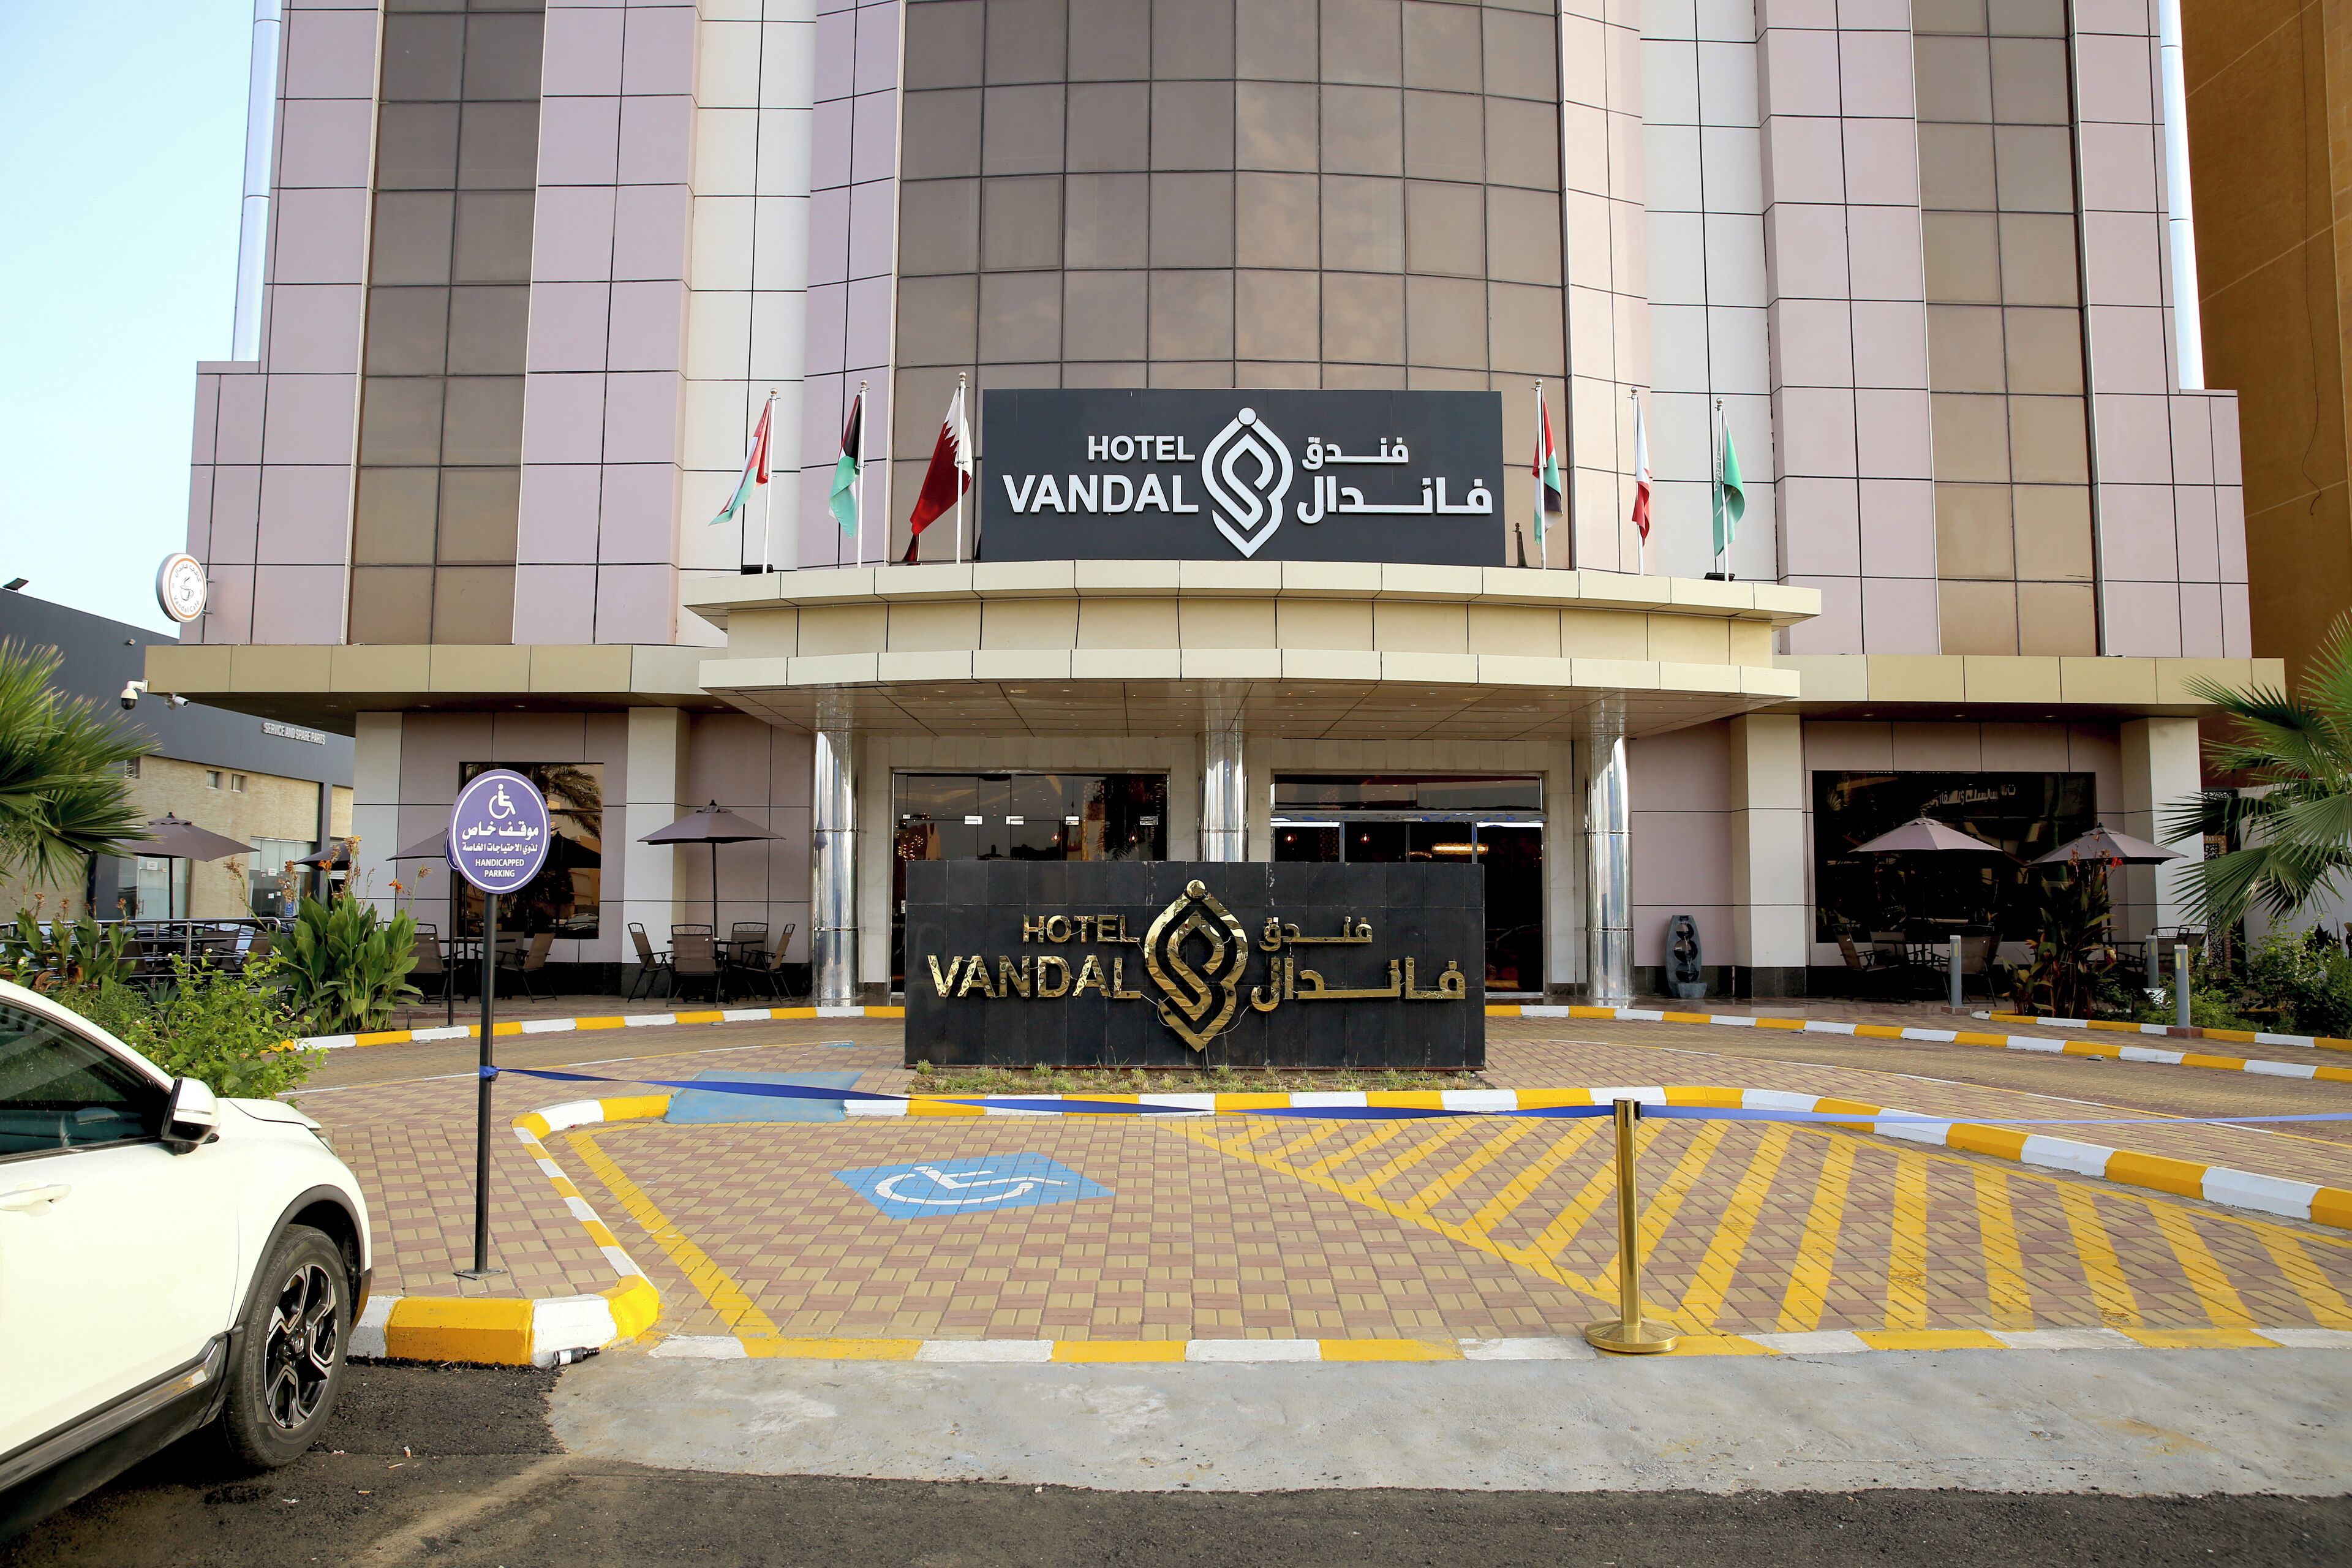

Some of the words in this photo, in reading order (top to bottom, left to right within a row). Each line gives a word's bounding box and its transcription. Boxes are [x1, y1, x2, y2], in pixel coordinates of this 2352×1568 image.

[1087, 435, 1196, 461] HOTEL
[1302, 436, 1409, 470] فندق
[1002, 473, 1200, 513] VANDAL
[1297, 475, 1494, 524] فاندال
[174, 595, 189, 612] Vandal
[263, 723, 285, 736] SERVICE
[285, 727, 295, 739] AND
[295, 729, 311, 742] SPARE
[311, 732, 325, 745] PARTS
[462, 821, 496, 840] خاص
[499, 820, 539, 841] موقف
[462, 842, 486, 852] الخاصة
[475, 858, 525, 867] HANDICAPPED
[484, 869, 515, 878] PARKING
[1023, 914, 1140, 943] HOTEL
[1259, 916, 1373, 951] فندق
[927, 954, 1142, 999] VANDAL
[1251, 957, 1466, 1012] فاندال
